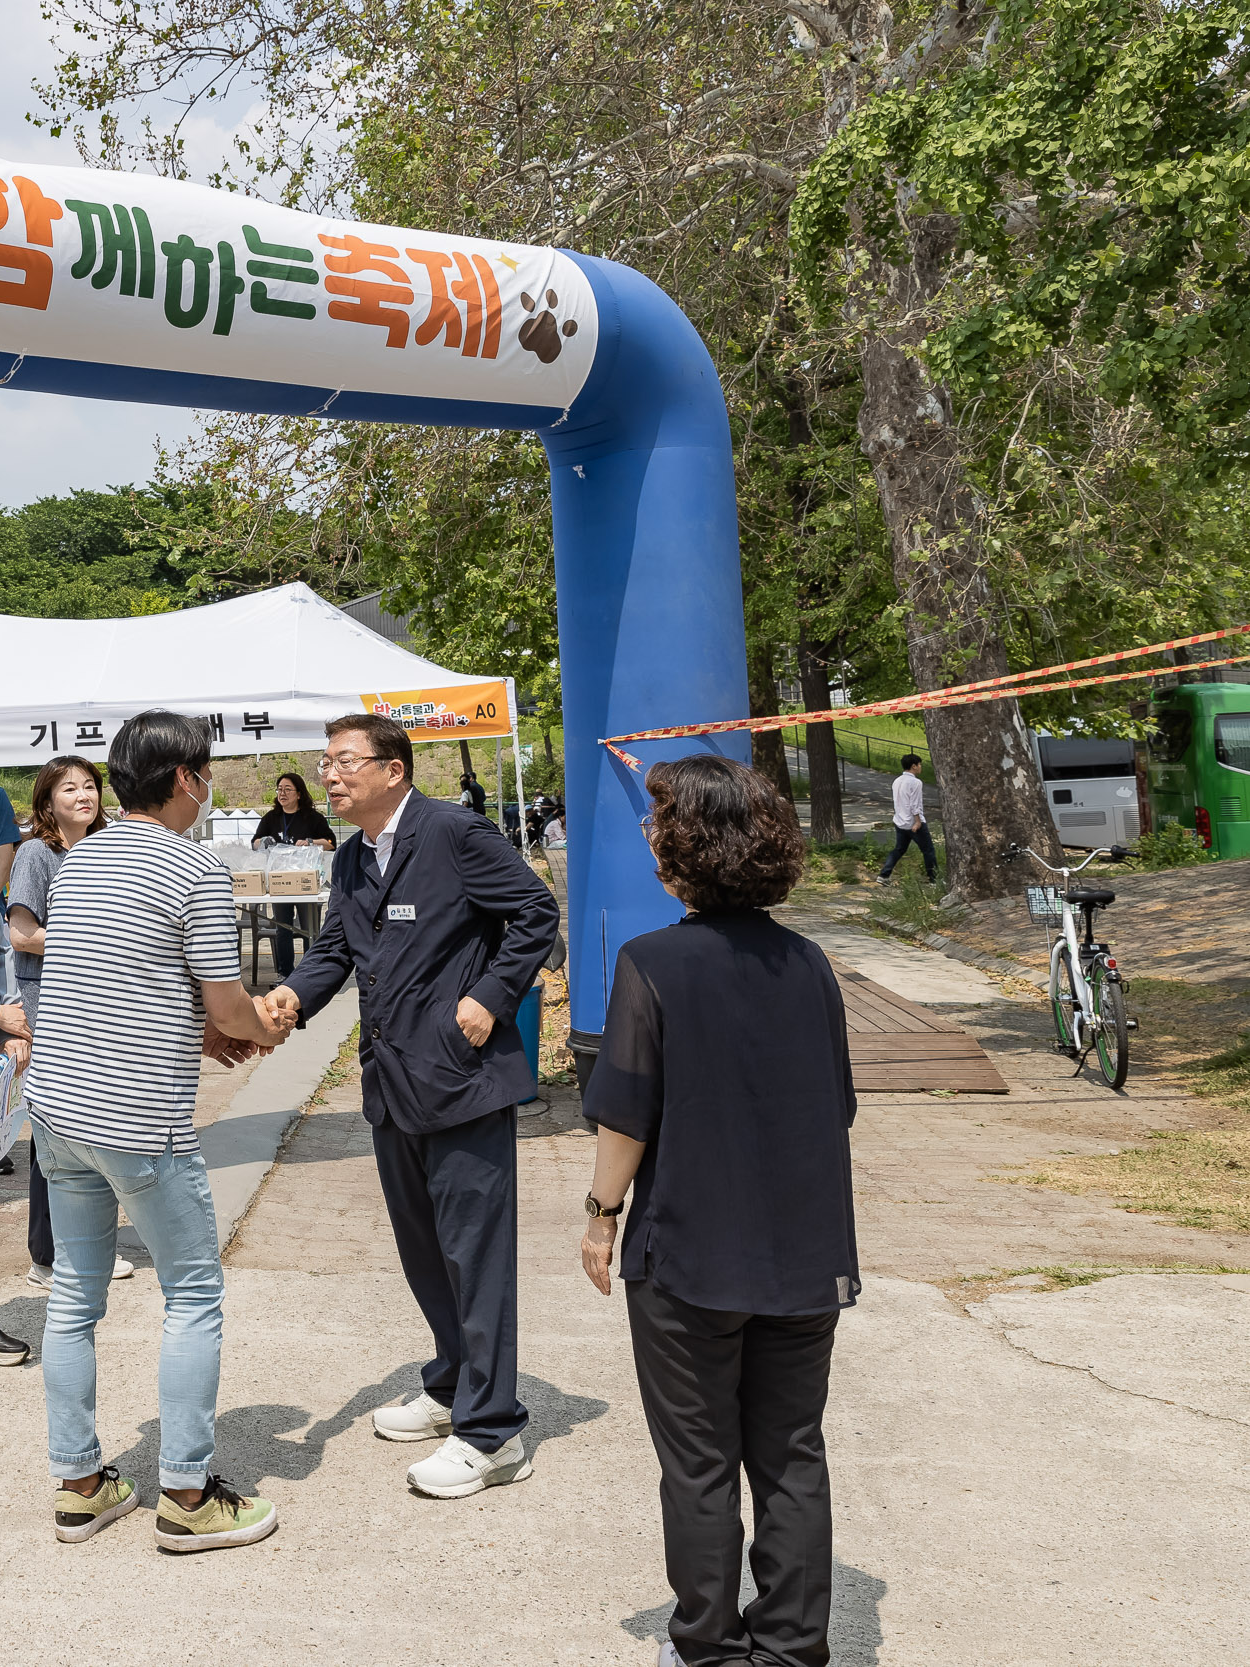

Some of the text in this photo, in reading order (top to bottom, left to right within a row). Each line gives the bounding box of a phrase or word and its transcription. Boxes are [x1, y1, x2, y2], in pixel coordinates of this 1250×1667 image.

[317, 232, 503, 360] 축제
[30, 719, 129, 751] 기프
[425, 713, 455, 729] 축제
